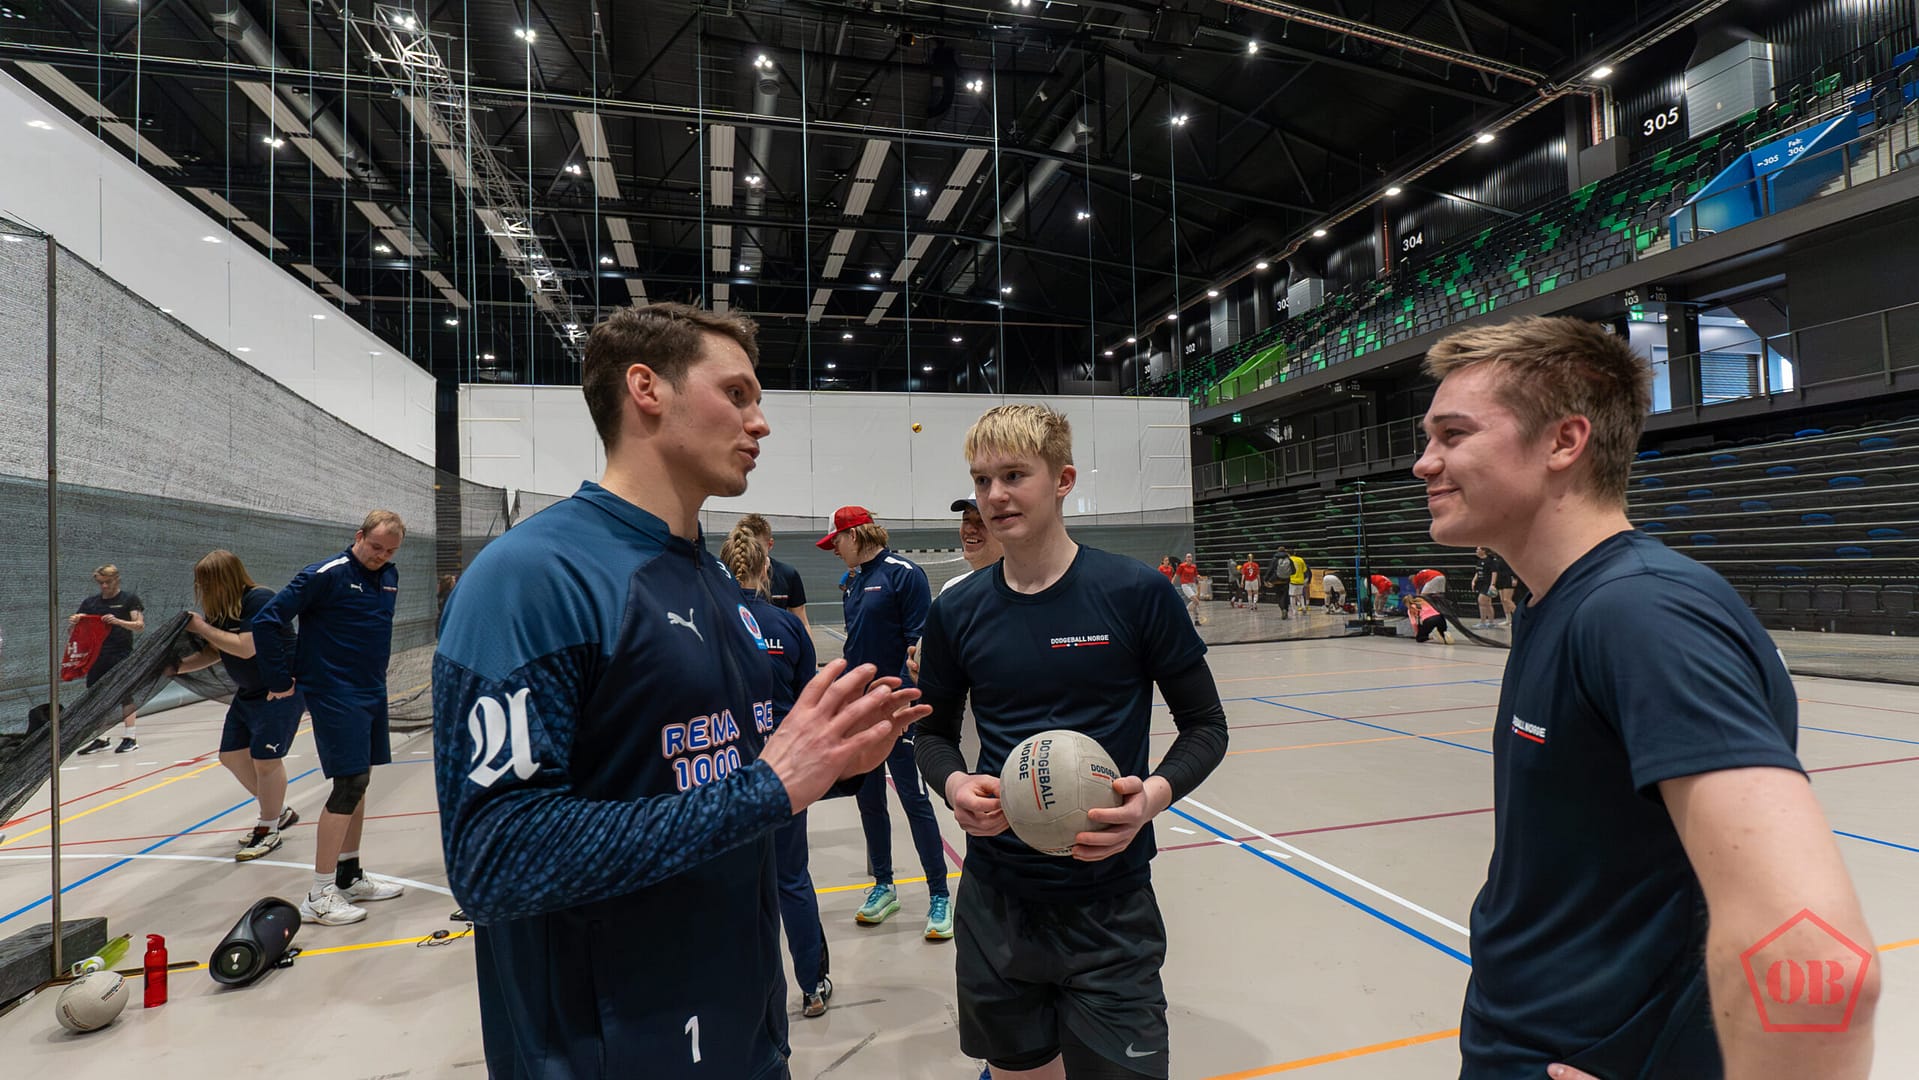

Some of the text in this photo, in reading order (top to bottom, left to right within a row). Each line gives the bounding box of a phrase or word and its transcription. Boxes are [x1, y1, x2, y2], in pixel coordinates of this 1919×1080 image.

[1643, 106, 1680, 136] 305
[1787, 145, 1805, 157] 306
[1402, 231, 1423, 251] 304
[1623, 294, 1640, 307] 103
[1050, 634, 1110, 645] DODGEBALL NORGE
[661, 708, 741, 759] REMA
[672, 745, 742, 792] 1000
[1018, 742, 1034, 781] NORGE
[1038, 739, 1056, 810] DODGEBALL
[684, 1015, 702, 1063] 1
